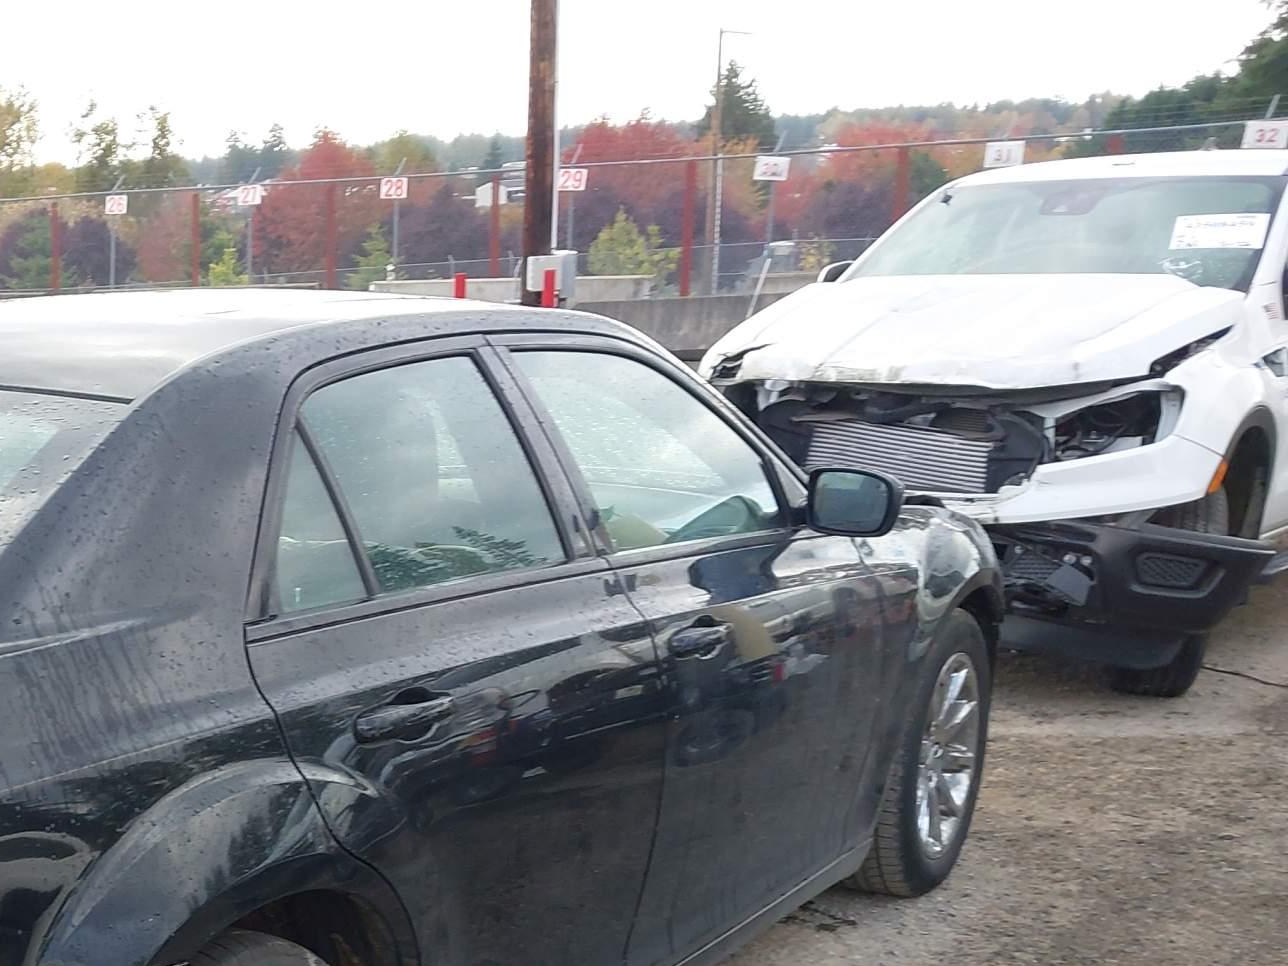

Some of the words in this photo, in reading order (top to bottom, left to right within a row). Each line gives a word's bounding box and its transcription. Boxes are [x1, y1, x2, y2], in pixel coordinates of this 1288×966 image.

[1255, 128, 1279, 143] 32
[383, 178, 404, 198] 28
[558, 169, 584, 189] 29
[241, 186, 258, 204] 27
